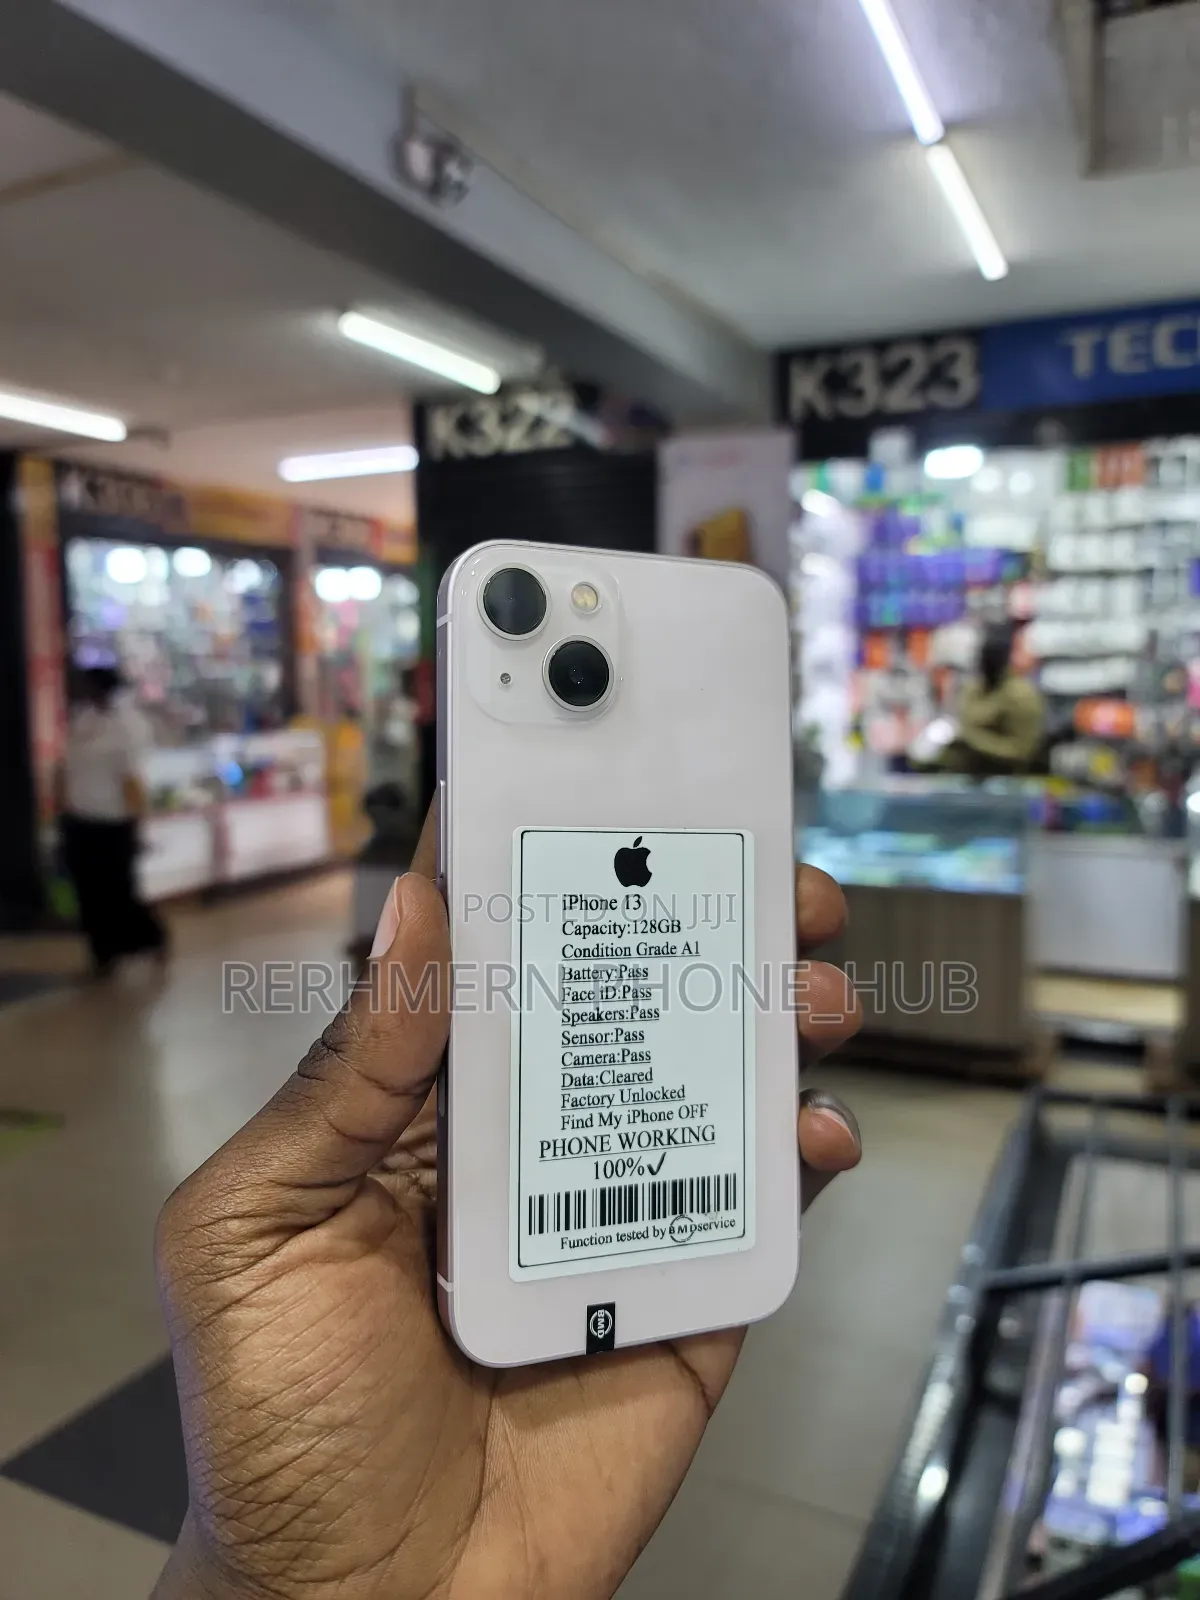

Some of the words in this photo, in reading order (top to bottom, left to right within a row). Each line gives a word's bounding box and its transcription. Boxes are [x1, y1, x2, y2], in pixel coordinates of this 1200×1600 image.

[1057, 314, 1200, 380] TEC
[787, 334, 981, 421] K323
[562, 894, 617, 911] iPhone
[625, 894, 641, 910] 13
[562, 919, 681, 939] Capacity:128GB
[562, 943, 631, 960] Condition
[636, 942, 677, 957] Grade
[682, 941, 700, 956] A1
[562, 965, 649, 983] Battery:Pass
[562, 987, 595, 1002] Face
[600, 985, 652, 1001] iD:Pass
[561, 1005, 660, 1026] Speakers:Pass
[561, 1027, 645, 1046] Sensor:Pass
[561, 1047, 651, 1067] Camera:Pass
[561, 1067, 653, 1088] Data:Cleared
[561, 1090, 615, 1109] Factory
[620, 1085, 686, 1102] Unlocked
[561, 1112, 593, 1130] Find
[598, 1111, 623, 1129] My
[627, 1107, 674, 1124] iPhone
[678, 1103, 709, 1119] OFF
[539, 1134, 612, 1159] PHONE
[618, 1124, 716, 1150] WORKING
[594, 1156, 645, 1180] 100%
[561, 1231, 612, 1250] Function
[616, 1226, 649, 1243] tested
[652, 1224, 667, 1240] by
[597, 1309, 605, 1339] BMD
